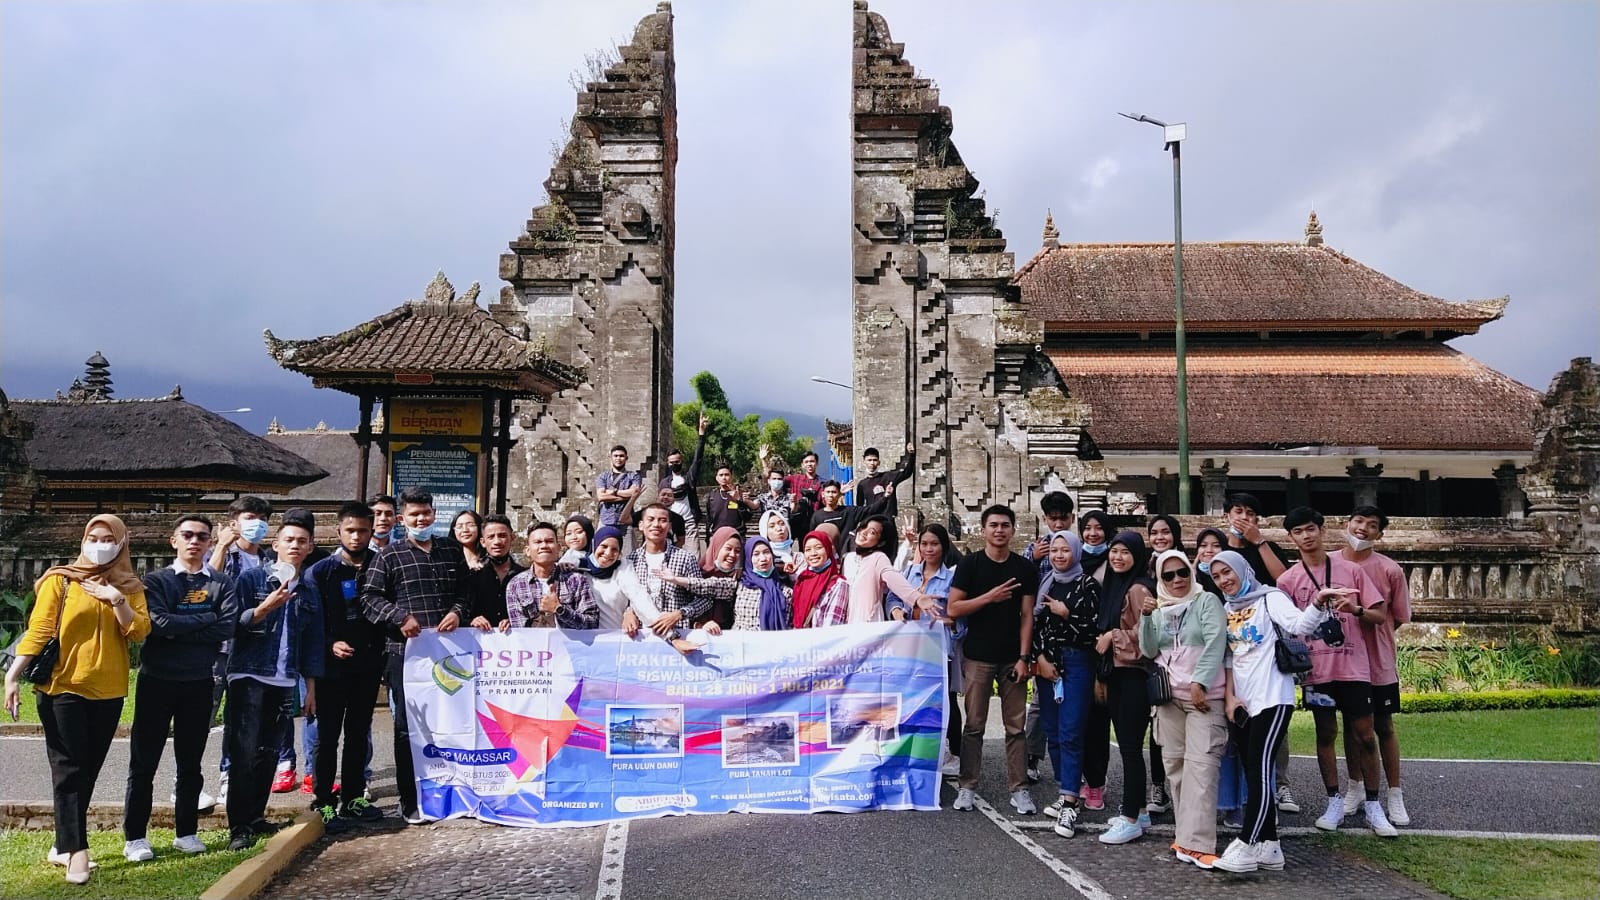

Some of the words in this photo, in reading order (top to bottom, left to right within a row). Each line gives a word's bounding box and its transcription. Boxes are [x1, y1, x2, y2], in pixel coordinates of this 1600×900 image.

[401, 416, 463, 428] BERATAN
[410, 450, 467, 459] PENGUMUMAN
[477, 650, 553, 669] PSPP
[637, 670, 682, 682] SISWA
[725, 683, 757, 695] JUNI
[768, 682, 777, 694] 1
[453, 752, 511, 765] MAKASSAR
[612, 763, 633, 771] PURA
[778, 769, 792, 777] LOT
[542, 801, 588, 809] ORGANIZED
[589, 801, 599, 809] BY
